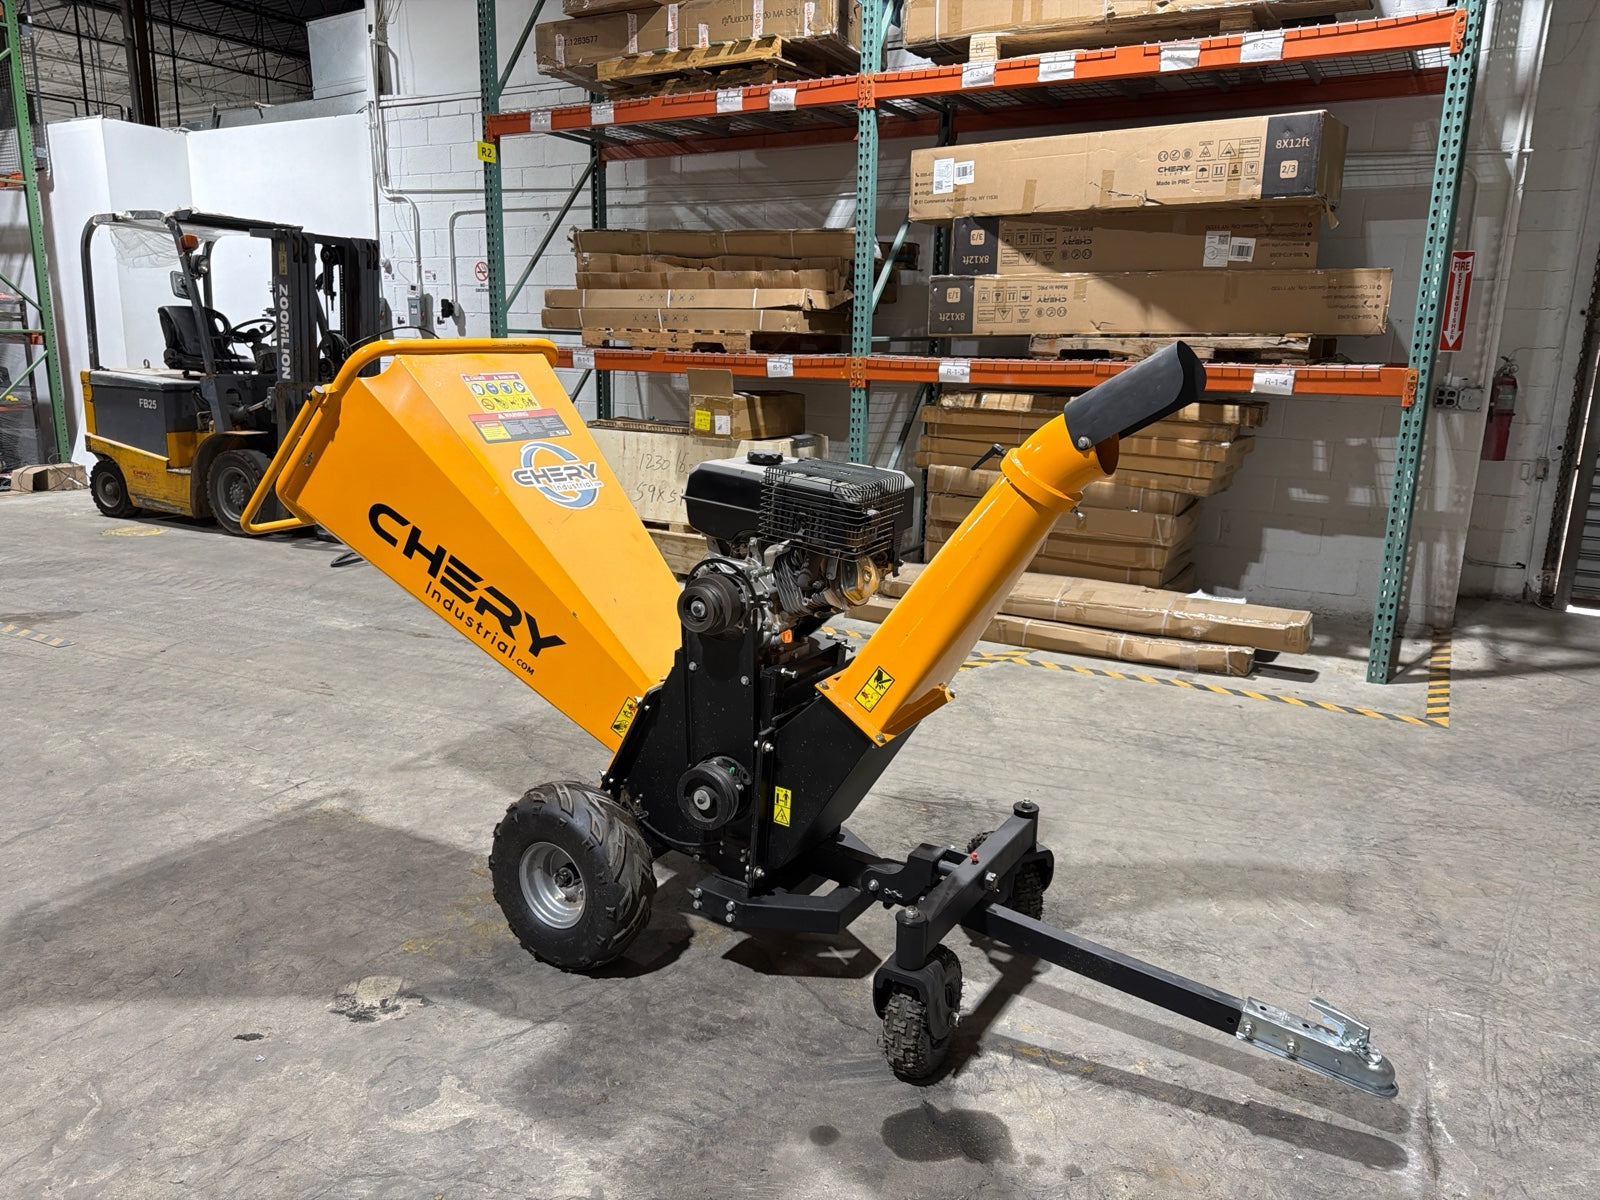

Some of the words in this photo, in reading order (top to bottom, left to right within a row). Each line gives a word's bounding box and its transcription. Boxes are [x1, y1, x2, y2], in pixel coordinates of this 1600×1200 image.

[1276, 138, 1310, 149] 8X12ft
[482, 146, 492, 158] R2
[1158, 165, 1190, 173] CHERY
[1282, 164, 1296, 174] 2/3
[972, 232, 984, 241] 3/3
[962, 255, 990, 264] 8X12ft
[1454, 261, 1470, 271] FIRE
[948, 291, 959, 299] 1/3
[1450, 272, 1462, 340] EXTINGUISHER
[939, 312, 965, 321] 8X12ft
[279, 284, 291, 380] ZOOMLION
[946, 368, 964, 376] R-1-3
[1265, 378, 1288, 386] R-1-4
[139, 398, 157, 410] FB25
[640, 453, 670, 471] 1230
[514, 464, 596, 486] CHERY
[368, 503, 567, 658] CHERY
